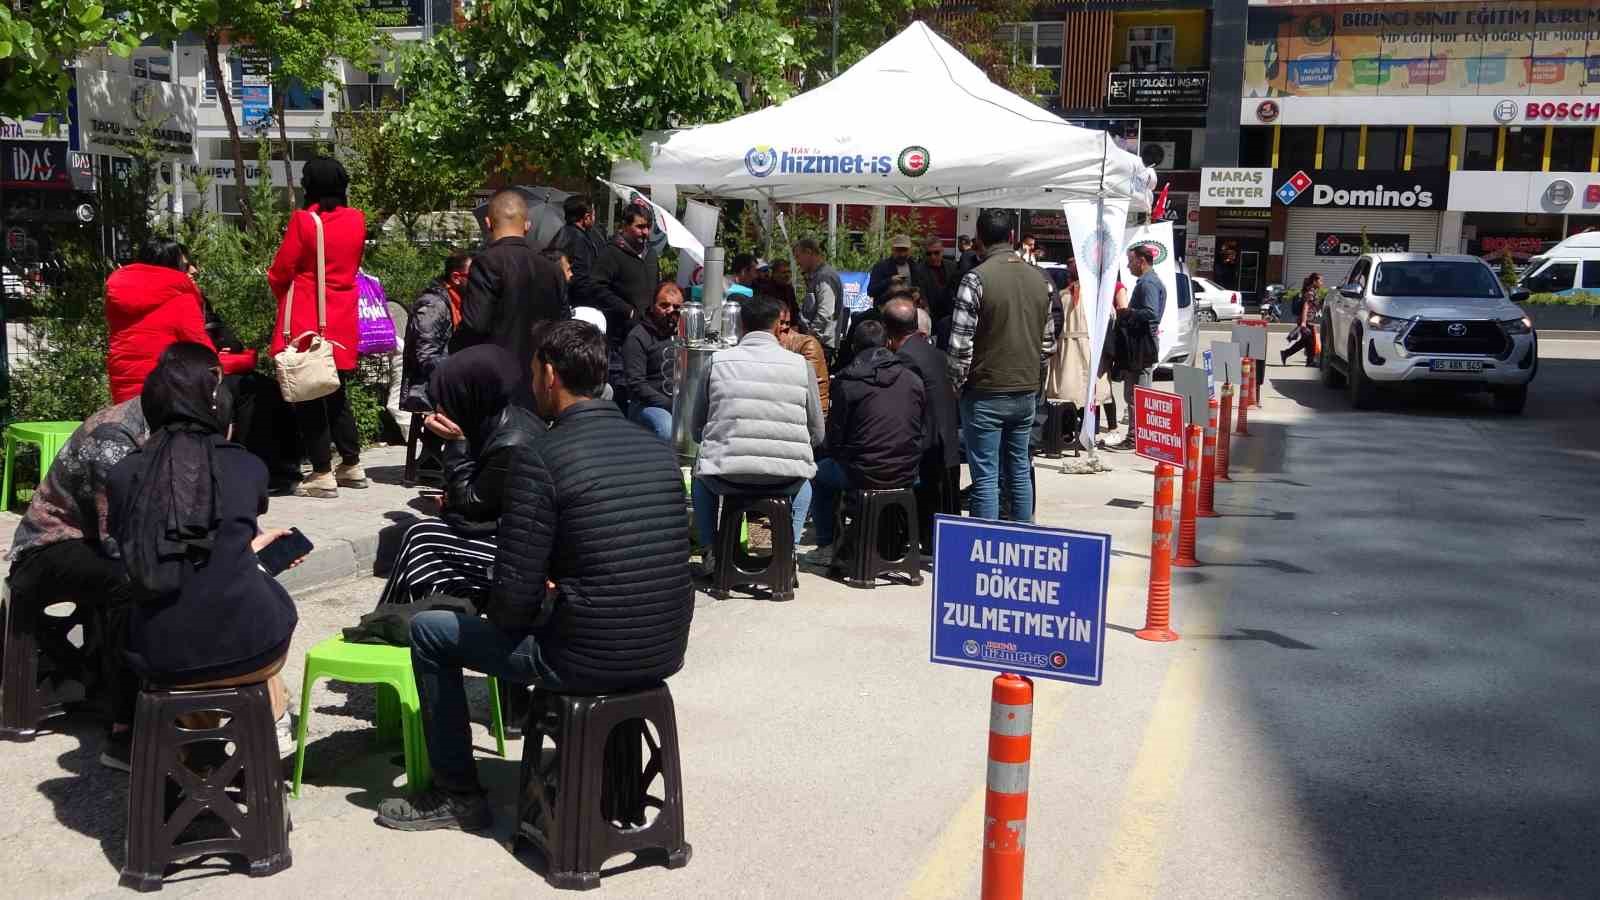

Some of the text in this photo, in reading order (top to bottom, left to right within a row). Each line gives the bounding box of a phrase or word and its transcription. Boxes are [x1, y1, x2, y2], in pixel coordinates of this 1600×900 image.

[1525, 102, 1600, 119] BOSCH
[780, 151, 892, 176] hizmet-iş
[1210, 170, 1264, 184] MARAŞ
[1207, 186, 1264, 199] CENTER
[1312, 184, 1433, 208] Domino's
[1340, 242, 1404, 254] Doino's
[1144, 396, 1173, 415] ALINTERİ
[1146, 411, 1172, 430] DÖKENE
[1137, 427, 1182, 449] ZULMETMEYİN
[969, 539, 1068, 572] ALINTERİ
[976, 568, 1060, 605] DÖKENE
[943, 602, 1091, 643] ZULMETMEYİN
